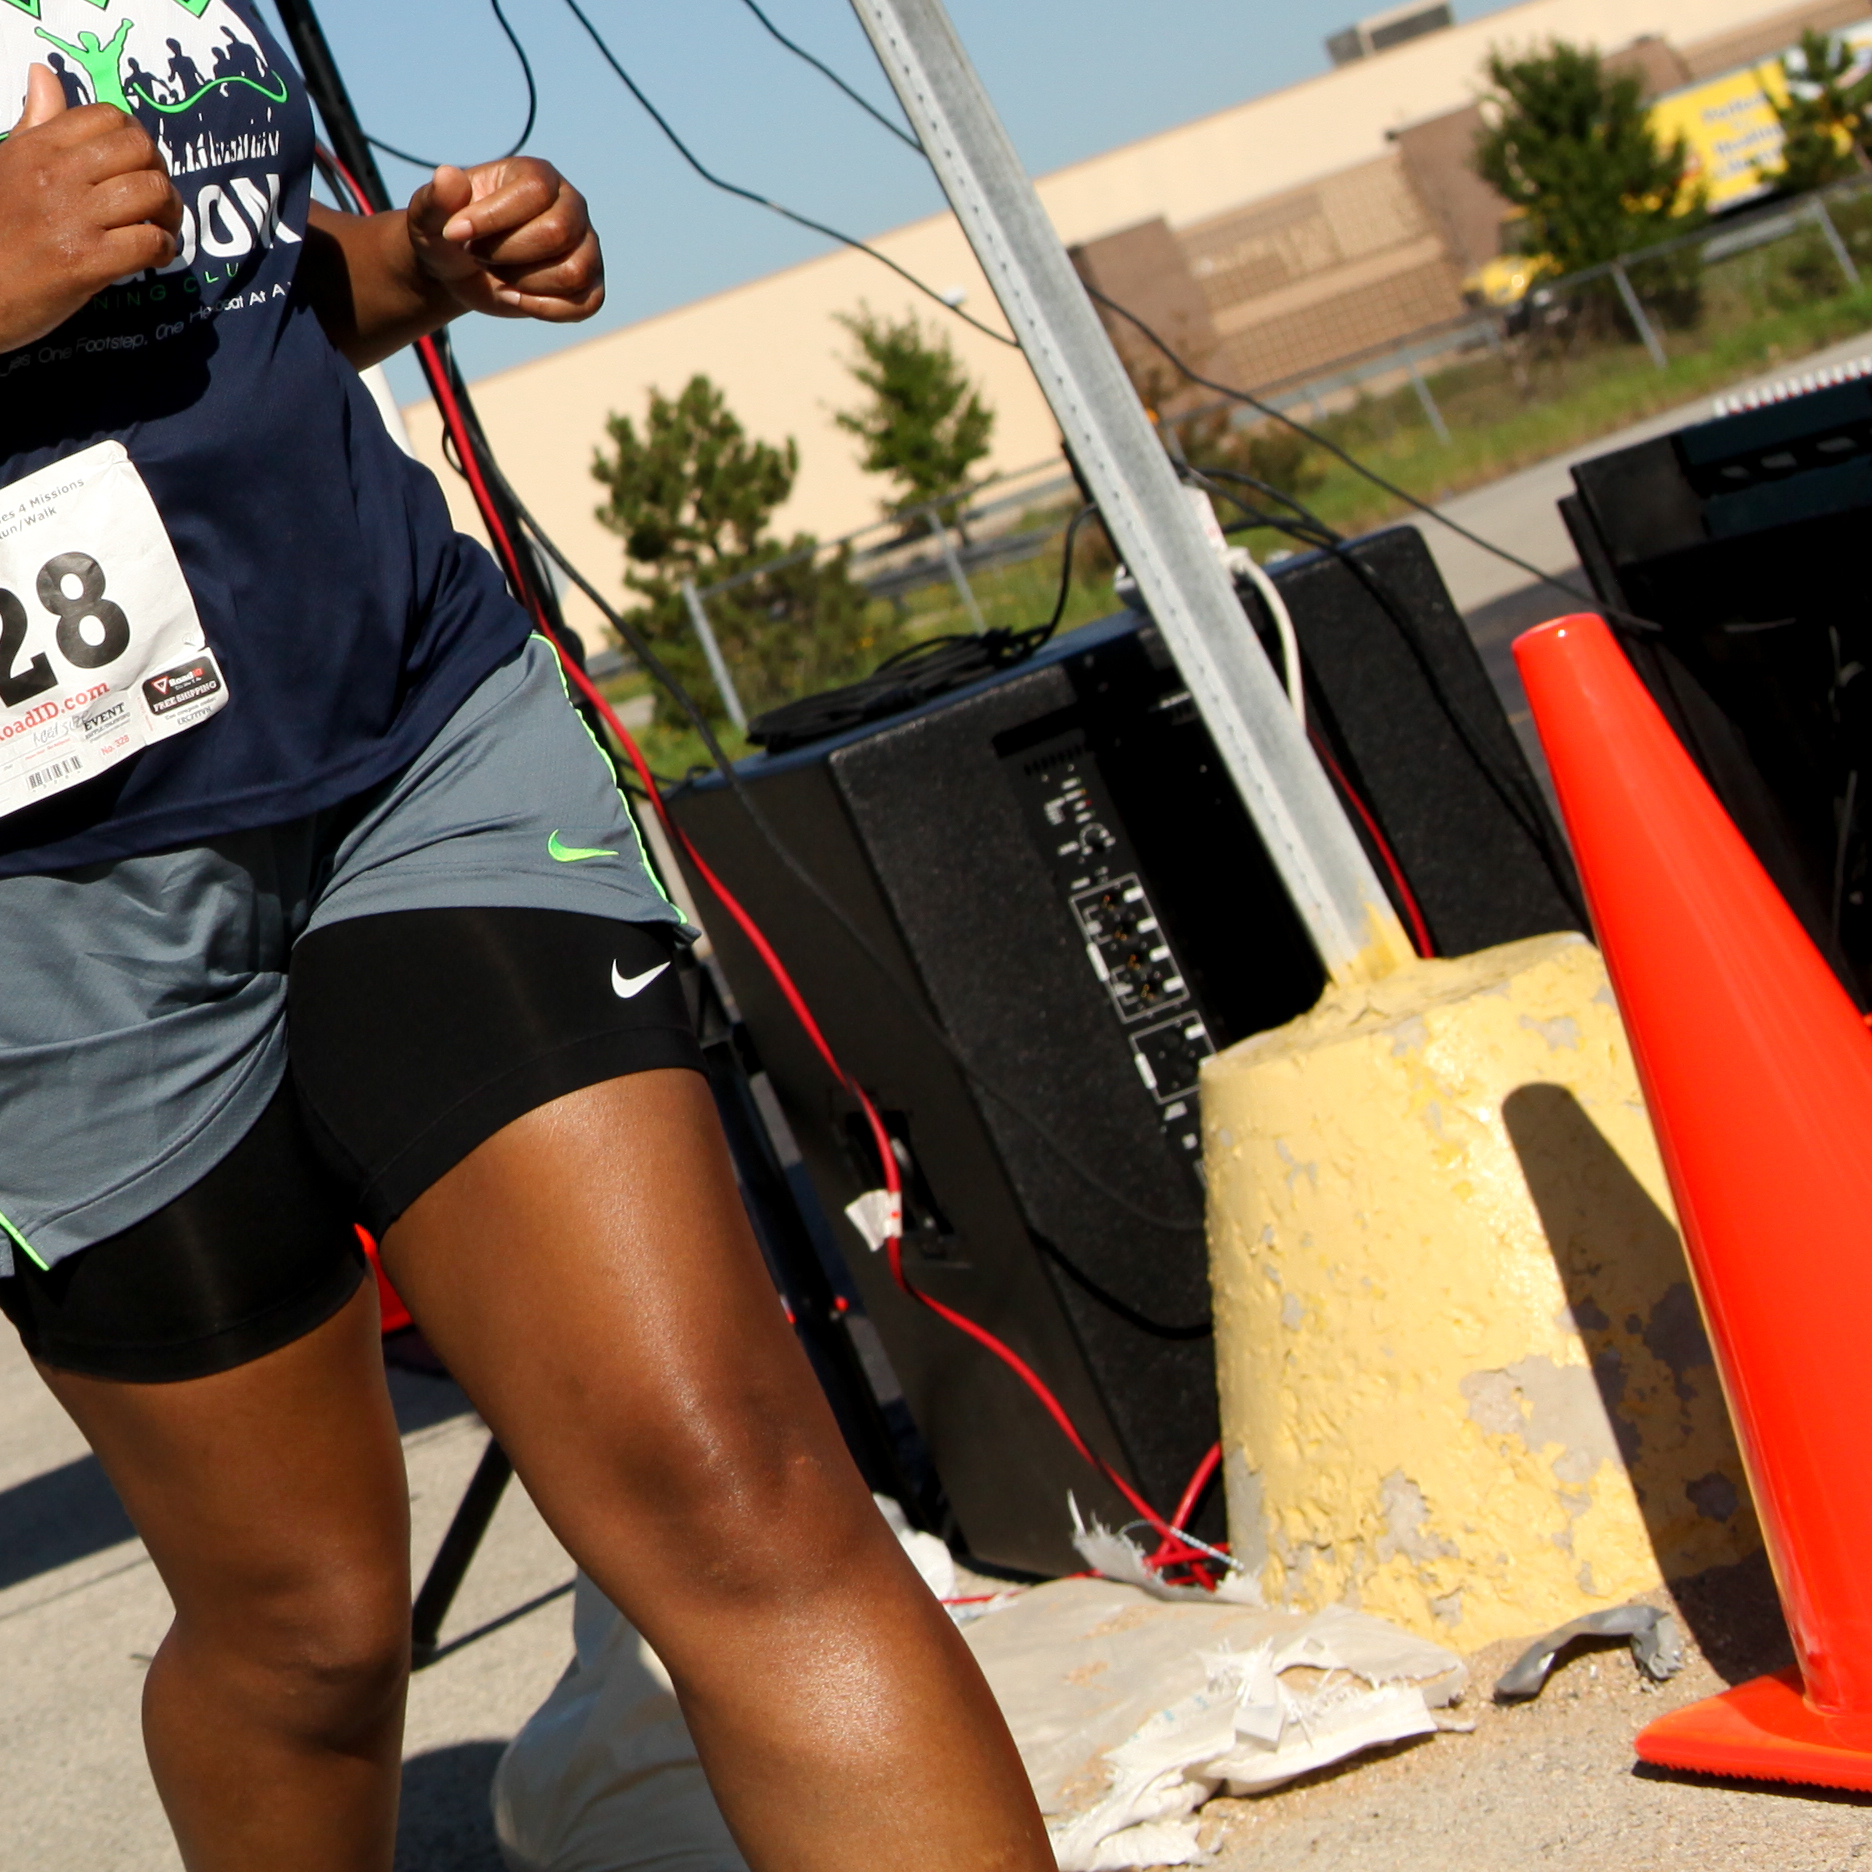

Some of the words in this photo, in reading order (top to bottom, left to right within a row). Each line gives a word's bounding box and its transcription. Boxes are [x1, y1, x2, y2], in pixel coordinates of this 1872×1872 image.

[18, 504, 27, 514] 4
[29, 478, 85, 508] Missions
[153, 697, 177, 713] FREE
[176, 680, 217, 704] SHIPPING
[82, 702, 125, 732] EVENT
[114, 734, 131, 748] 328
